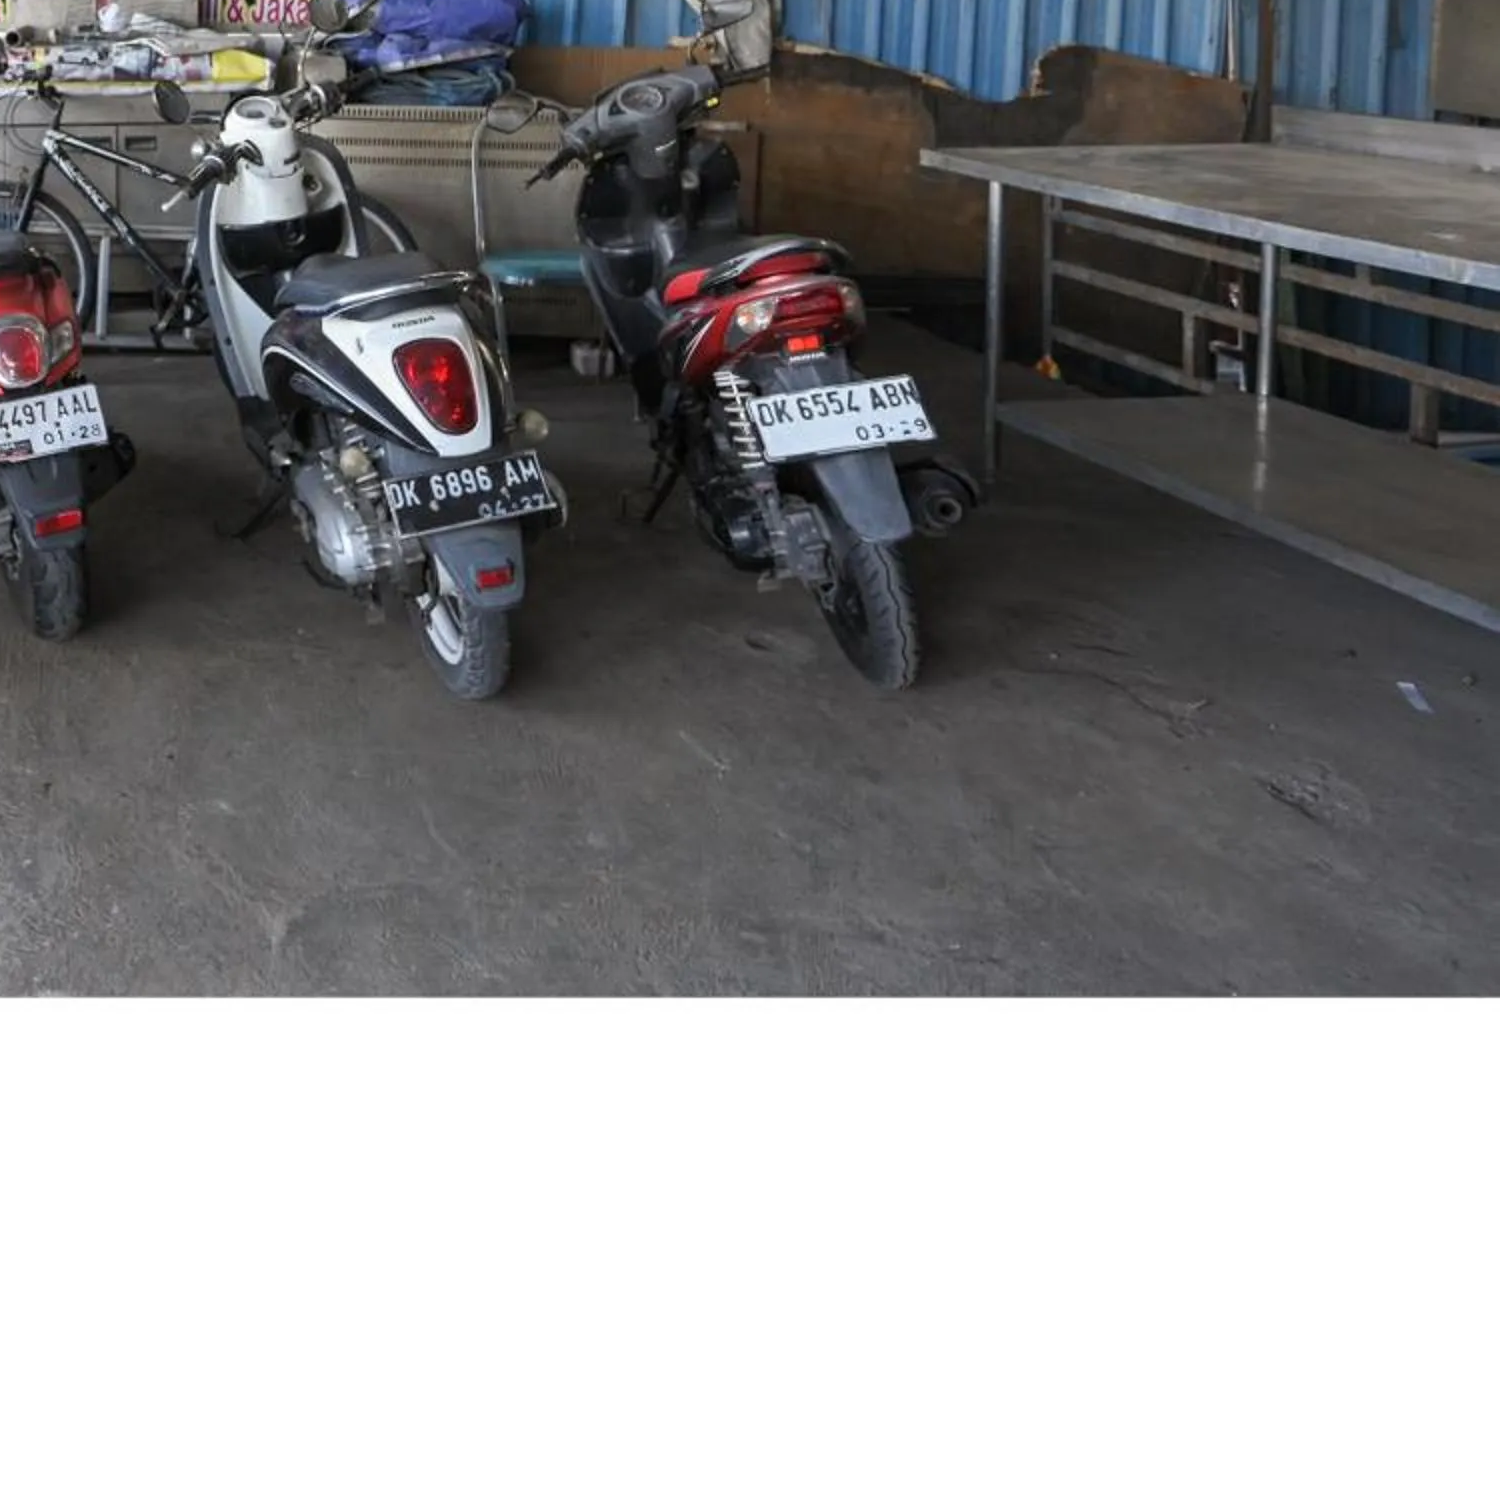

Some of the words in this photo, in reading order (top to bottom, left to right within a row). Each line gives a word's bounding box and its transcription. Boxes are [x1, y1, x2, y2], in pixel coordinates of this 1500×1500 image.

[56, 390, 98, 420] AAL
[757, 401, 795, 429] DK
[799, 389, 861, 422] 6554
[869, 379, 921, 414] ABN
[387, 481, 421, 511] DK
[429, 465, 493, 501] 6896
[503, 457, 539, 488] AM
